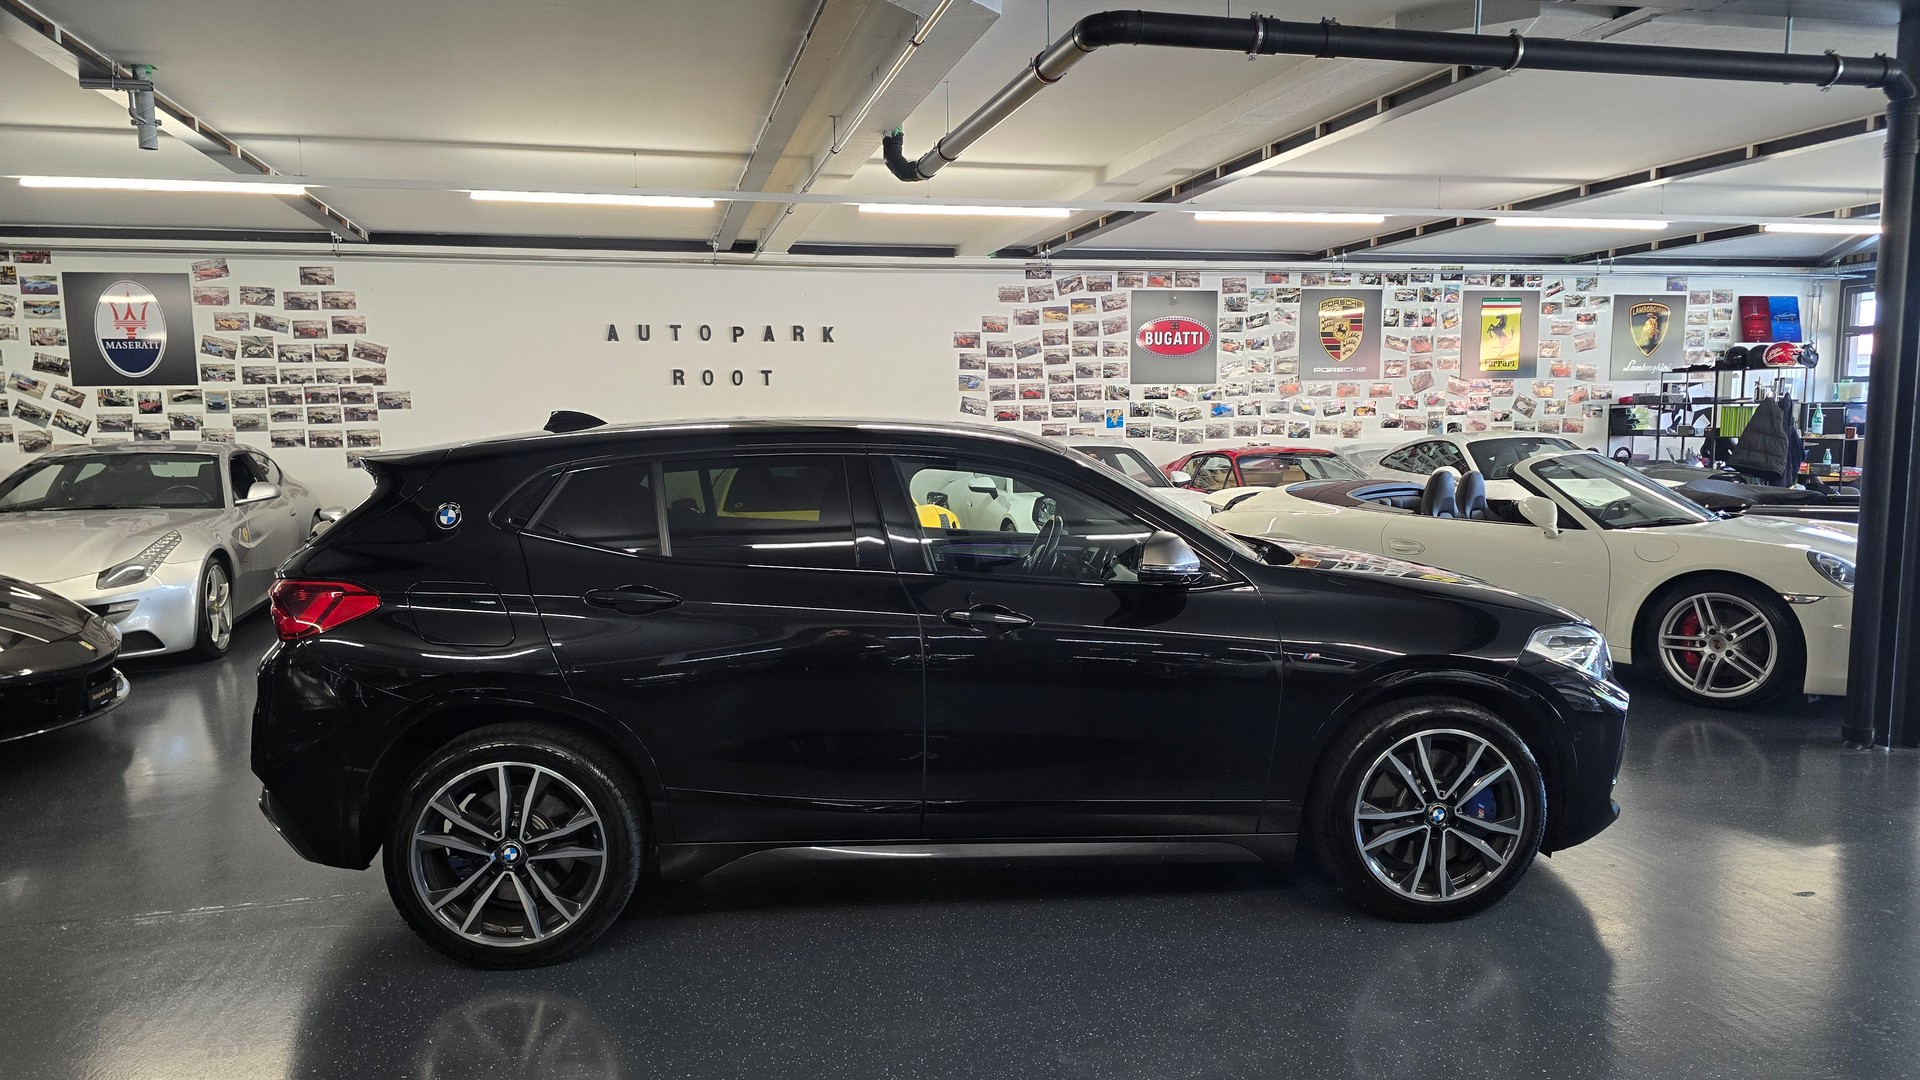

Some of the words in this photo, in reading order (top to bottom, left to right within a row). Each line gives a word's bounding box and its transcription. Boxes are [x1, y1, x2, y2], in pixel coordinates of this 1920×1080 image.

[1321, 299, 1363, 309] PORSCHE
[606, 324, 835, 343] AUTOPARK
[1145, 331, 1204, 346] BUGATTI
[105, 340, 159, 350] MASERATI
[1622, 359, 1672, 374] Lamborghini
[671, 369, 773, 386] ROOT
